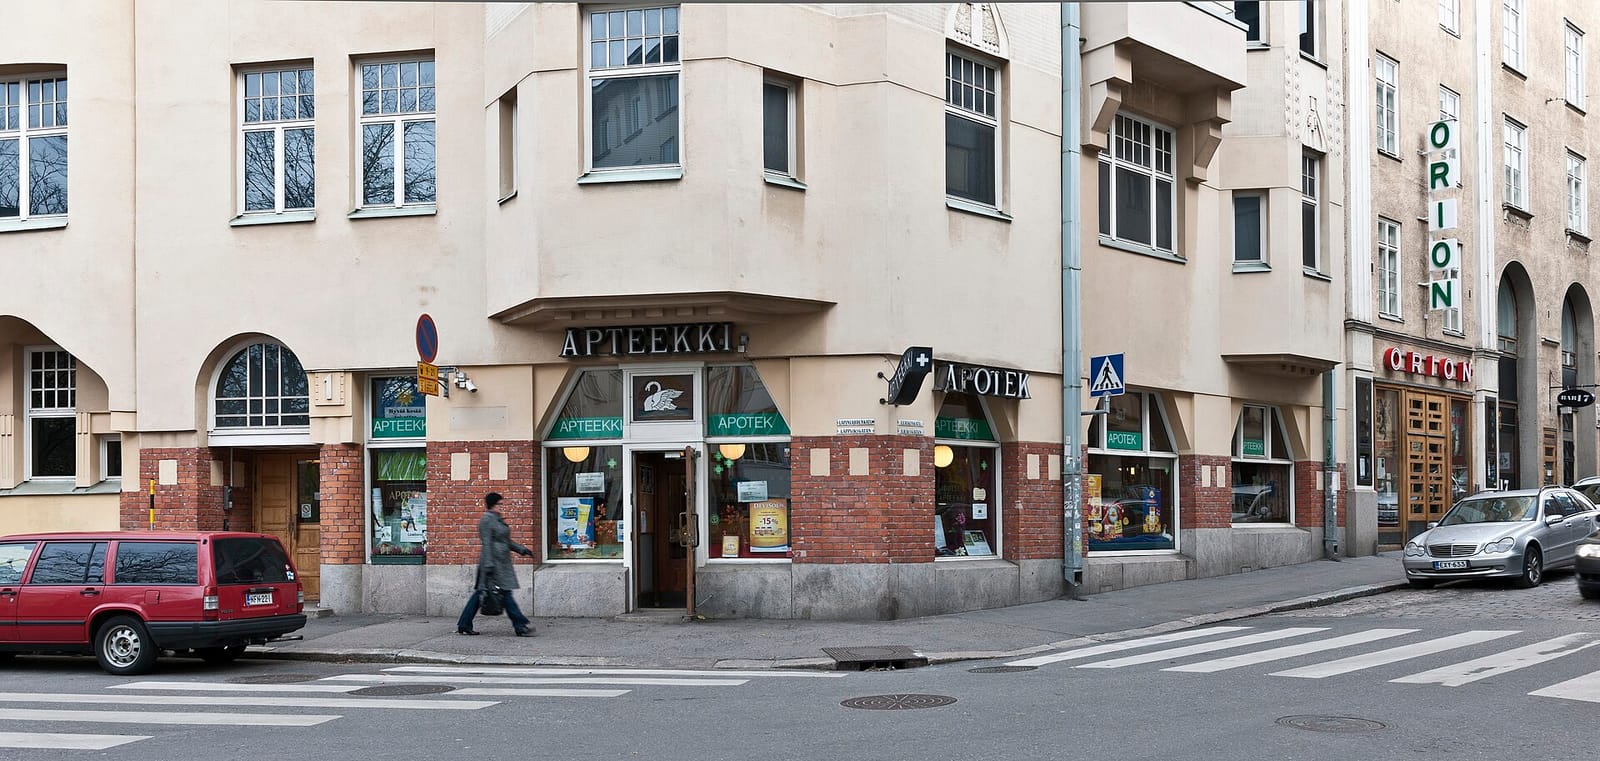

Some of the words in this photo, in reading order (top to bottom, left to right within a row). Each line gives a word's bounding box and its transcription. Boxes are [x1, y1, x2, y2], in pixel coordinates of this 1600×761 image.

[1430, 122, 1452, 309] ORION
[560, 323, 732, 356] APTEEKKI
[944, 363, 1032, 399] APOTEK
[1383, 347, 1473, 383] ORION
[560, 418, 623, 433] APTEEKKI
[718, 416, 774, 429] APOTEK
[1107, 432, 1137, 446] APOTEK
